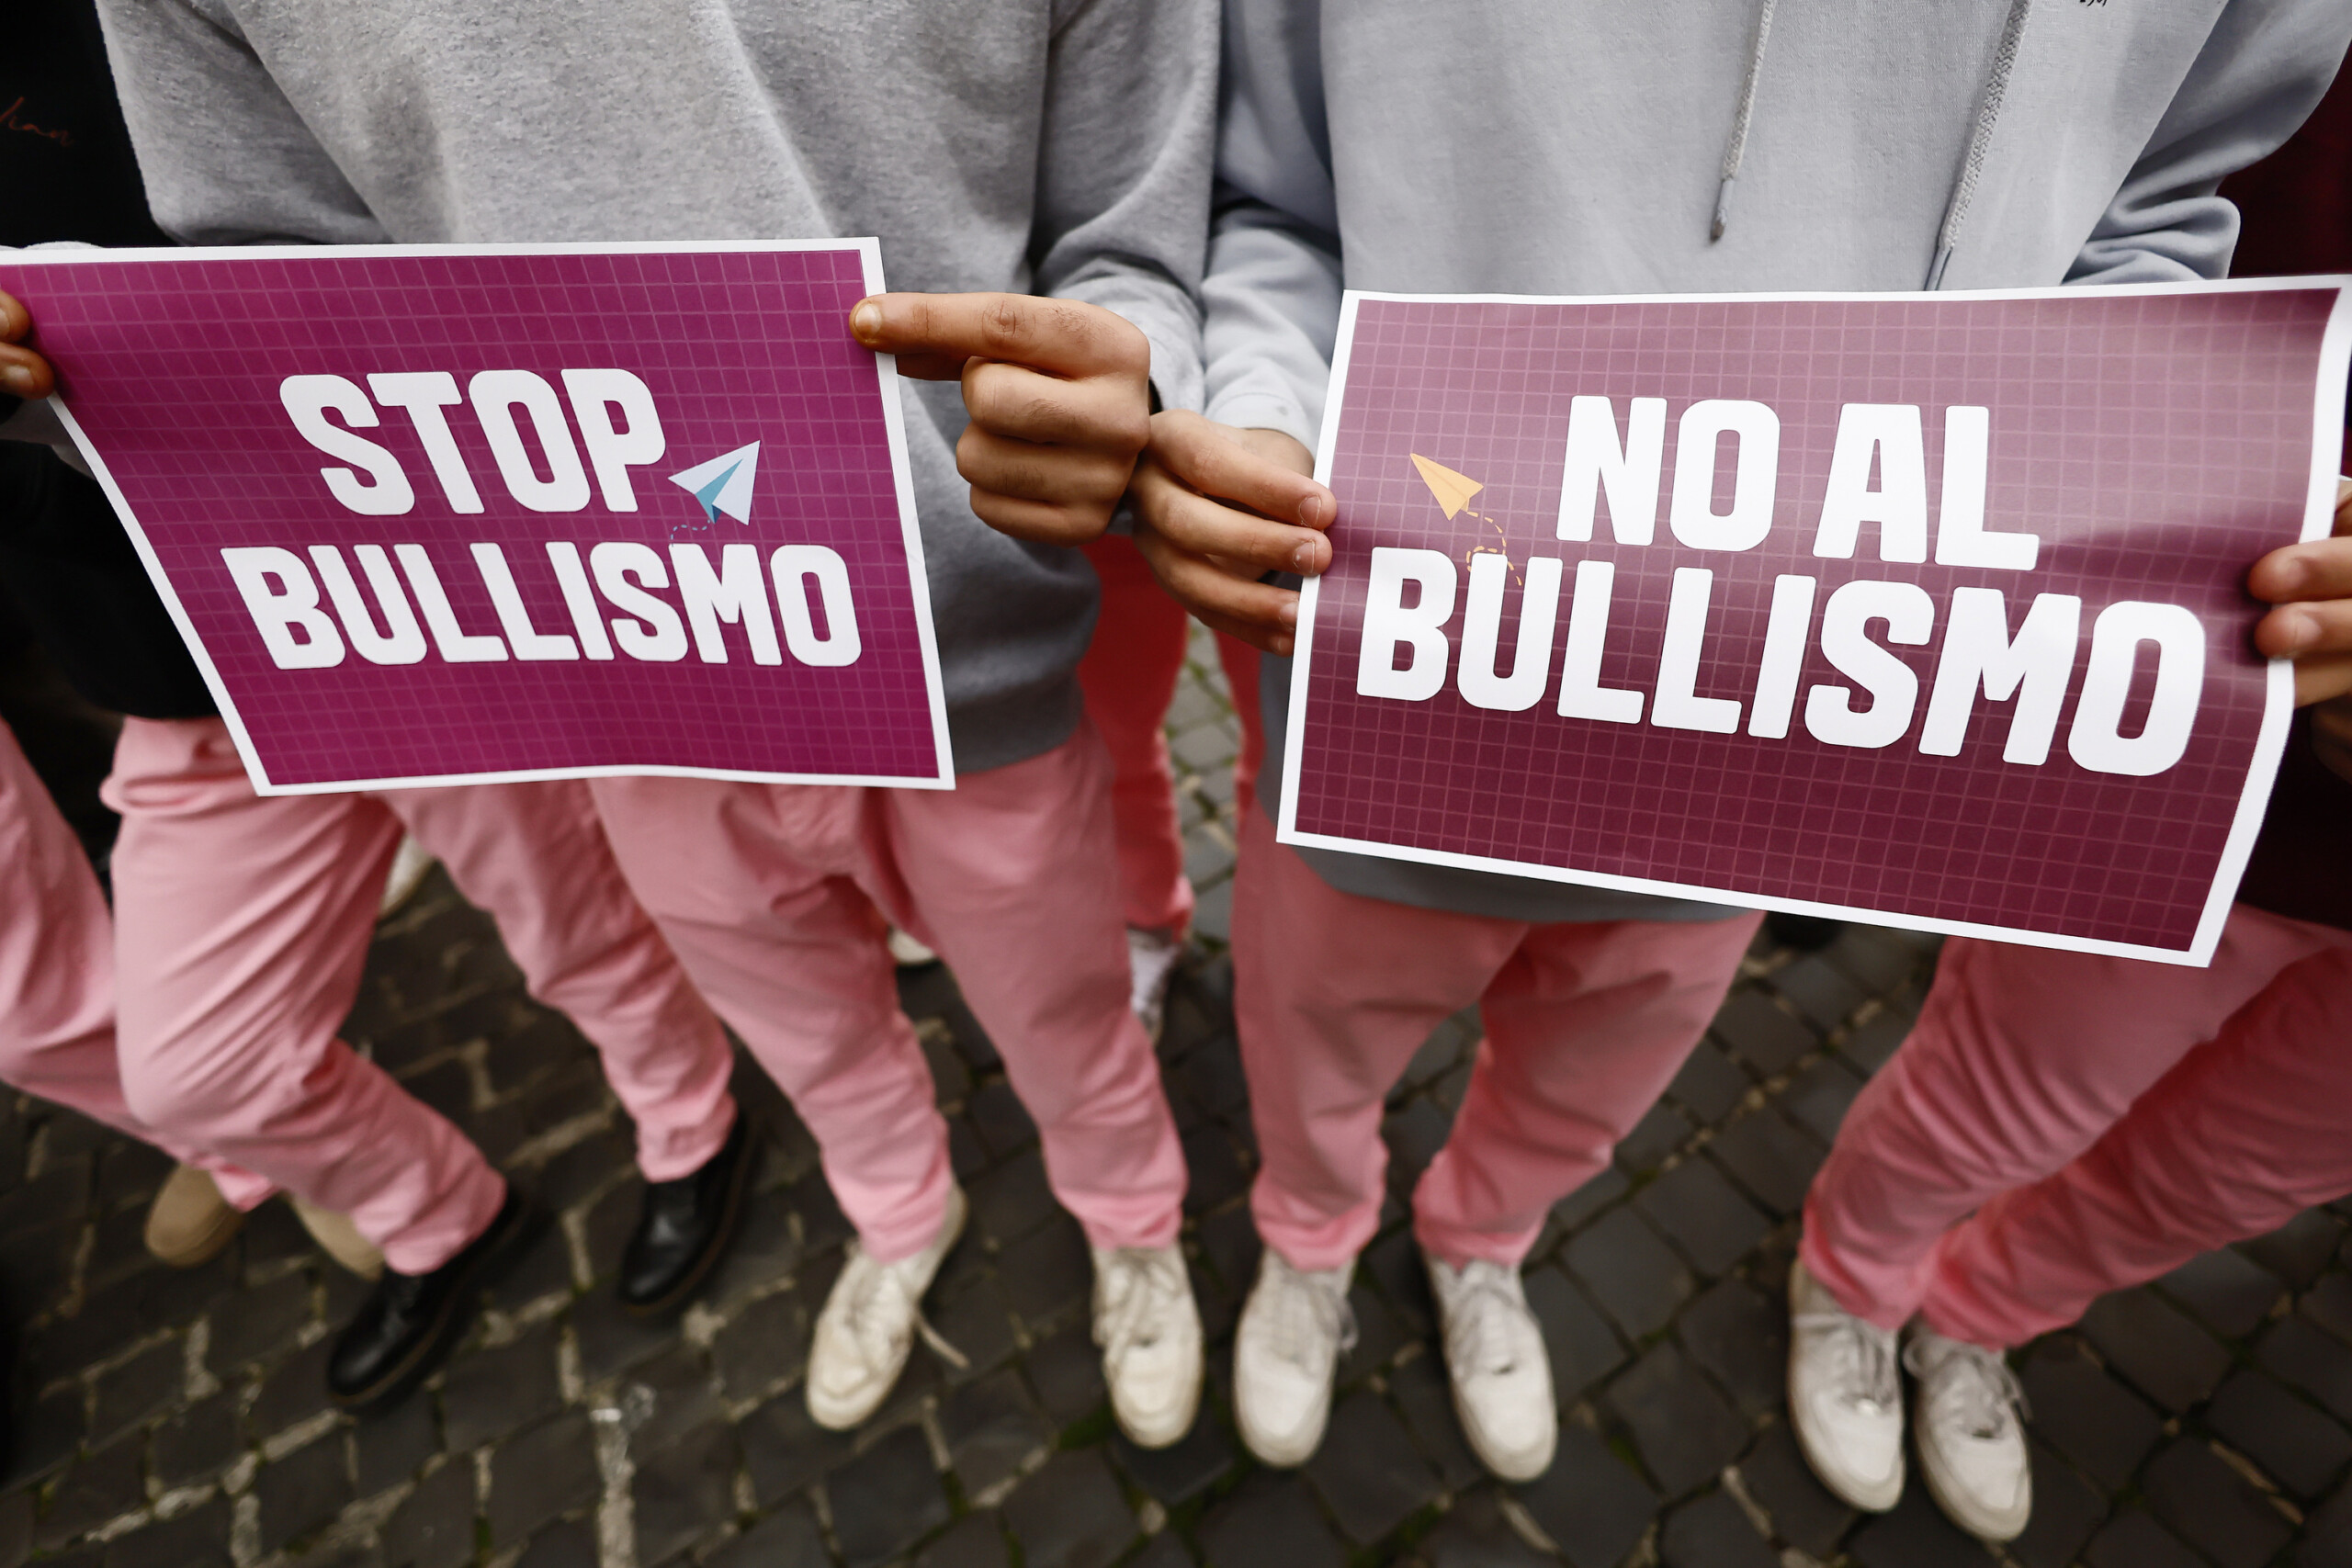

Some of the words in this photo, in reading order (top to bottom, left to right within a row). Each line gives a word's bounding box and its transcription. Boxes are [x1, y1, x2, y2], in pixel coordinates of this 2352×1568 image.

[280, 369, 666, 515] STOP
[1555, 395, 1781, 551] NO
[1812, 403, 2041, 570] AL
[220, 543, 862, 667] BULLISMO
[1356, 547, 2207, 776] BULLISMO
